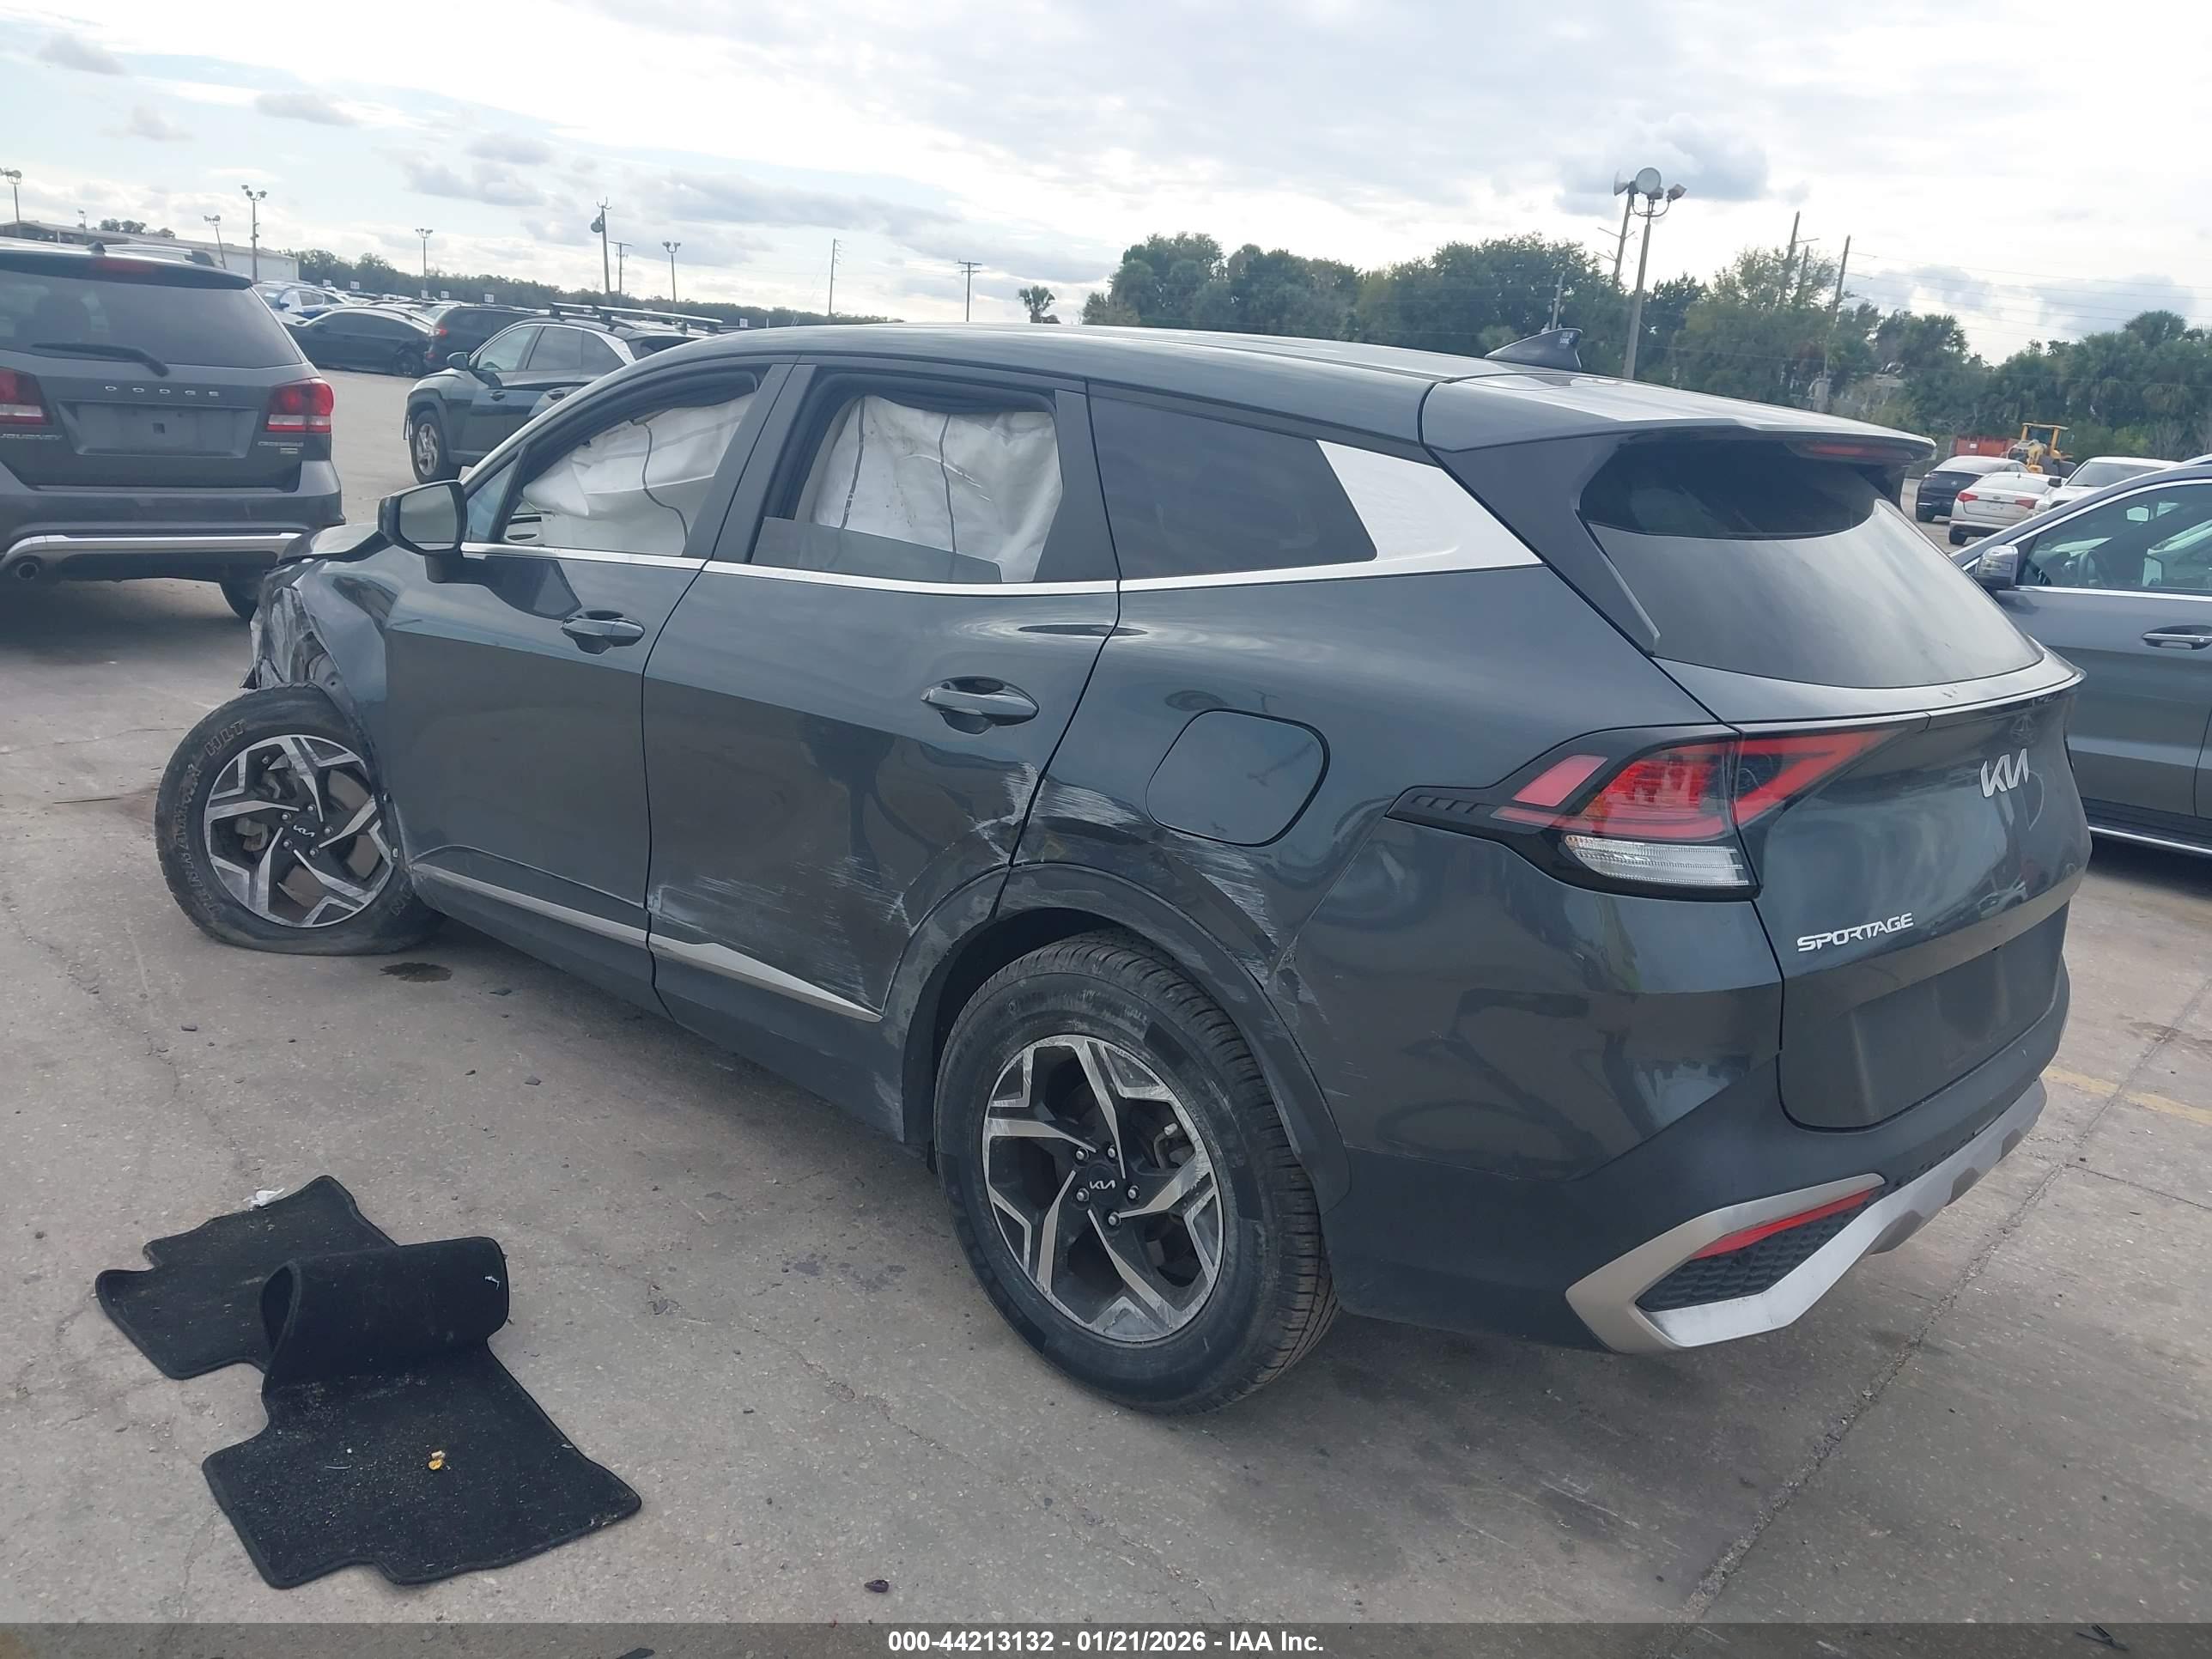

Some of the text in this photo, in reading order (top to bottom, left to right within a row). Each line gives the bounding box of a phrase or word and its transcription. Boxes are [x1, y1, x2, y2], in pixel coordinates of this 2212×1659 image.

[105, 385, 219, 397] DODGE
[1980, 748, 2029, 798] KIA
[1796, 912, 1914, 952] SPORTAGE
[1089, 1180, 1116, 1190] KIA
